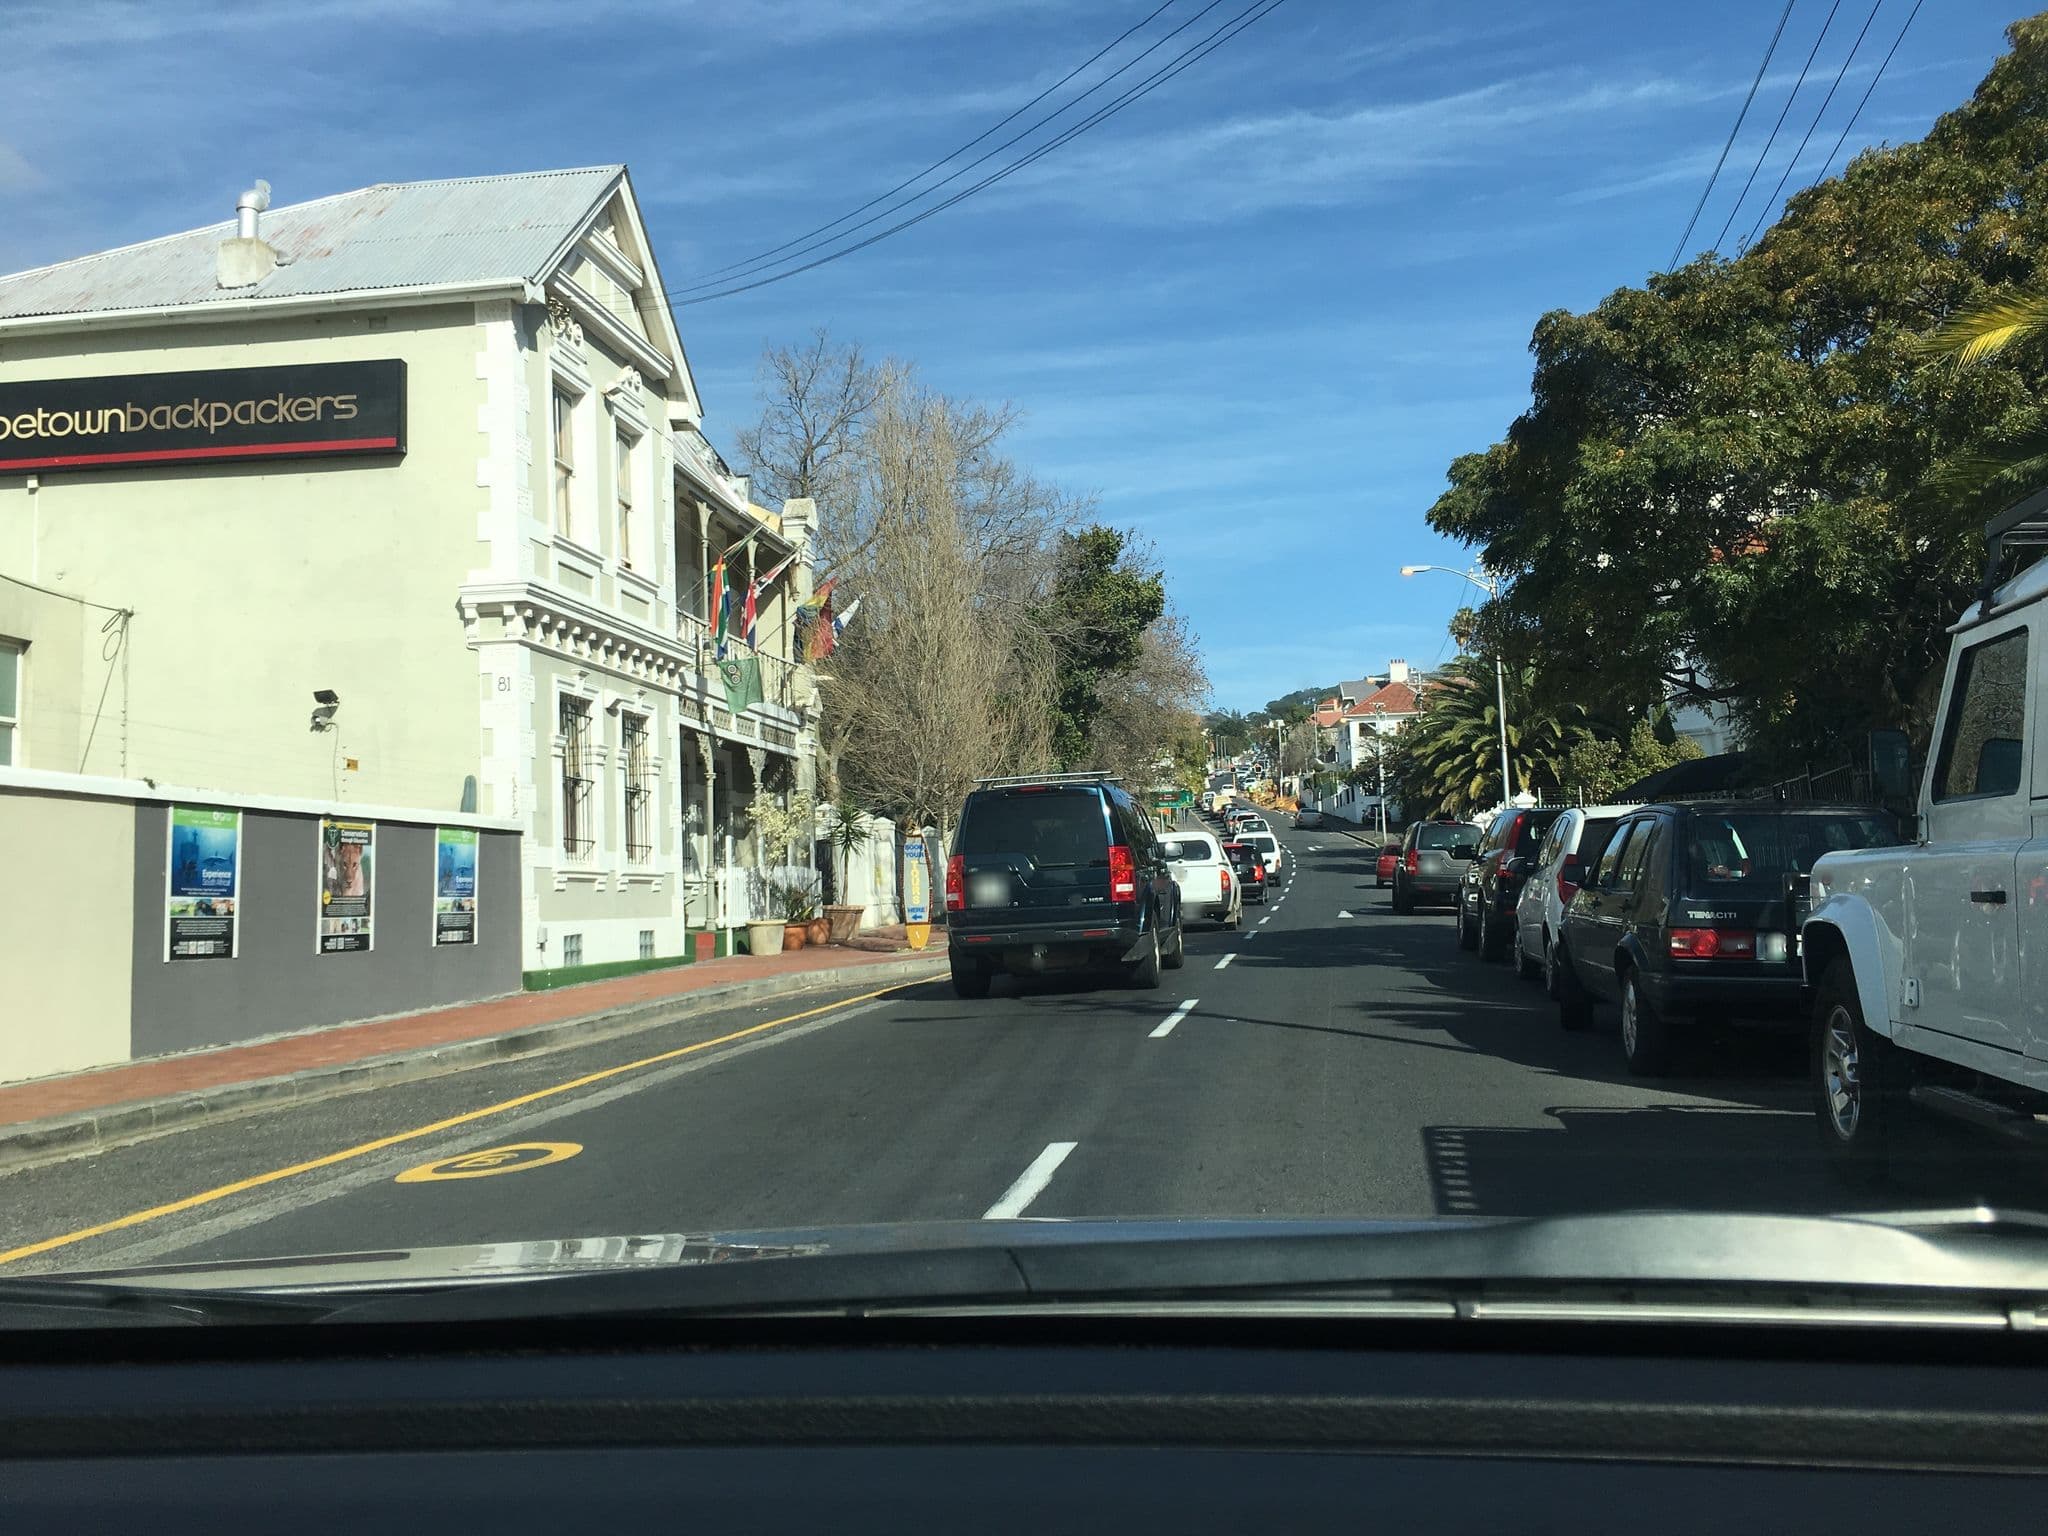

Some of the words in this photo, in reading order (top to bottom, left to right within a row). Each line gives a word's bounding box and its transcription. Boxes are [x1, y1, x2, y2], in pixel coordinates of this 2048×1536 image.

[498, 676, 511, 691] 81
[202, 869, 232, 880] Experience
[911, 860, 920, 905] TOURS
[1687, 910, 1737, 919] TENACITI
